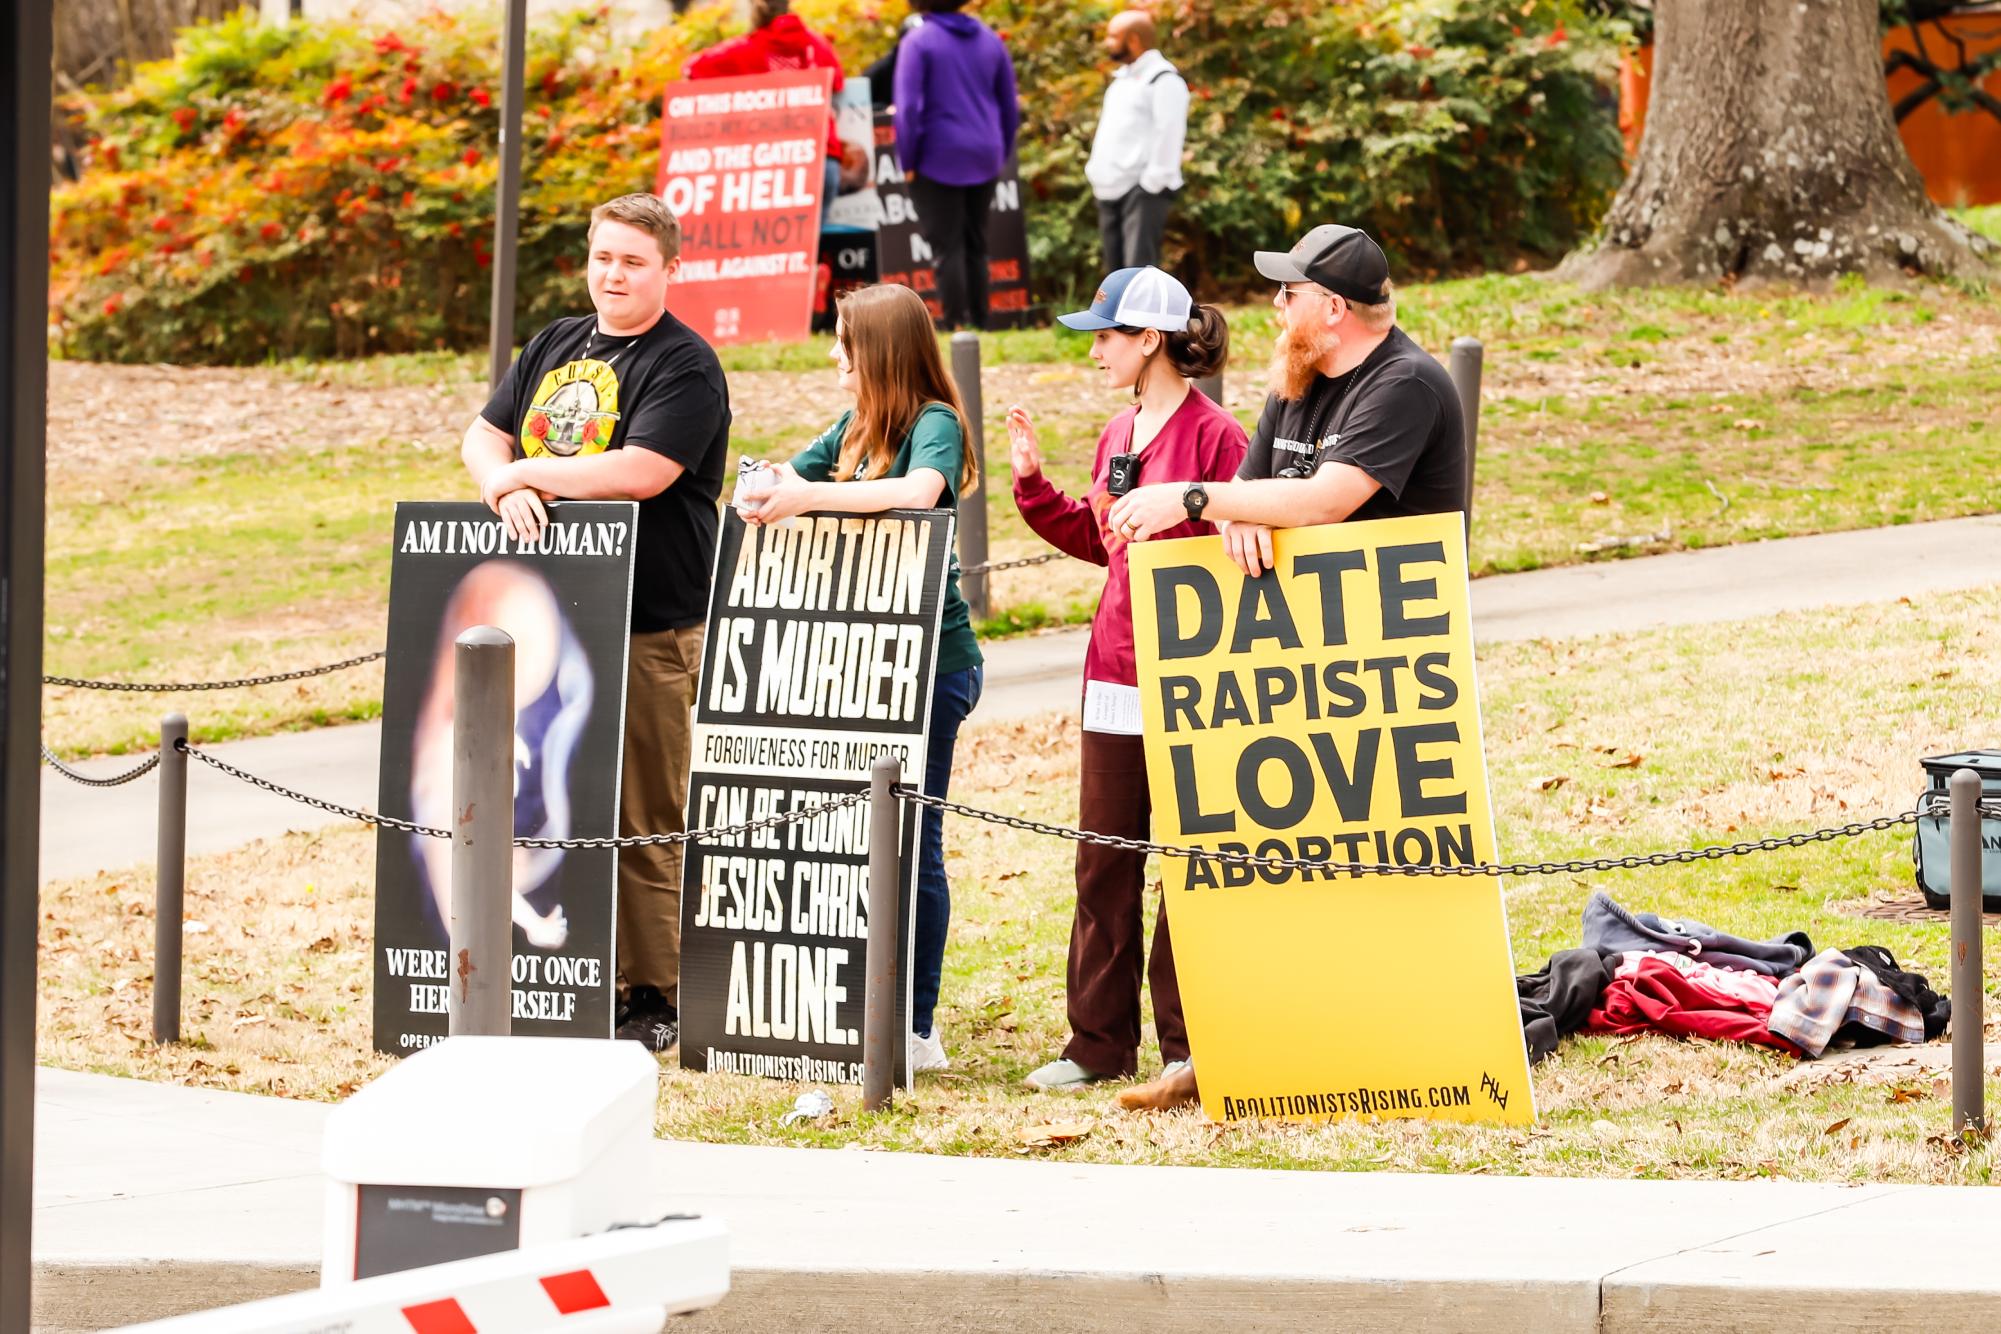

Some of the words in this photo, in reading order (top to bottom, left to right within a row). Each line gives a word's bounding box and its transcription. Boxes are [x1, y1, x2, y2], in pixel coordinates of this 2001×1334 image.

[669, 96, 695, 118] ON
[696, 92, 731, 116] THIS
[733, 89, 777, 112] ROCK
[787, 84, 825, 108] WILL
[667, 147, 712, 175] AND
[713, 143, 753, 171] THE
[753, 137, 817, 168] GATES
[663, 174, 717, 218] OF
[721, 166, 816, 214] HELL
[681, 220, 743, 250] HALL
[751, 214, 809, 246] NOT
[719, 252, 789, 280] AGAINST
[400, 520, 444, 555] AM
[445, 520, 458, 555] I
[460, 521, 509, 555] NOT
[727, 516, 932, 615] ABORTION
[1152, 540, 1451, 661] DATE
[709, 617, 755, 713] IS
[756, 618, 924, 722] MURDER
[1159, 652, 1459, 733] RAPISTS
[704, 734, 805, 768] FORGIVENESS
[811, 740, 839, 769] FOR
[1169, 721, 1468, 836] LOVE
[697, 785, 748, 849] CAN
[750, 788, 785, 851] BE
[788, 789, 872, 856] FOUND
[695, 854, 786, 933] JESUS
[790, 860, 870, 939] CHRIS
[385, 947, 448, 979] WERE
[511, 954, 542, 984] OT
[544, 956, 602, 987] ONCE
[725, 940, 859, 1046] ALONE.
